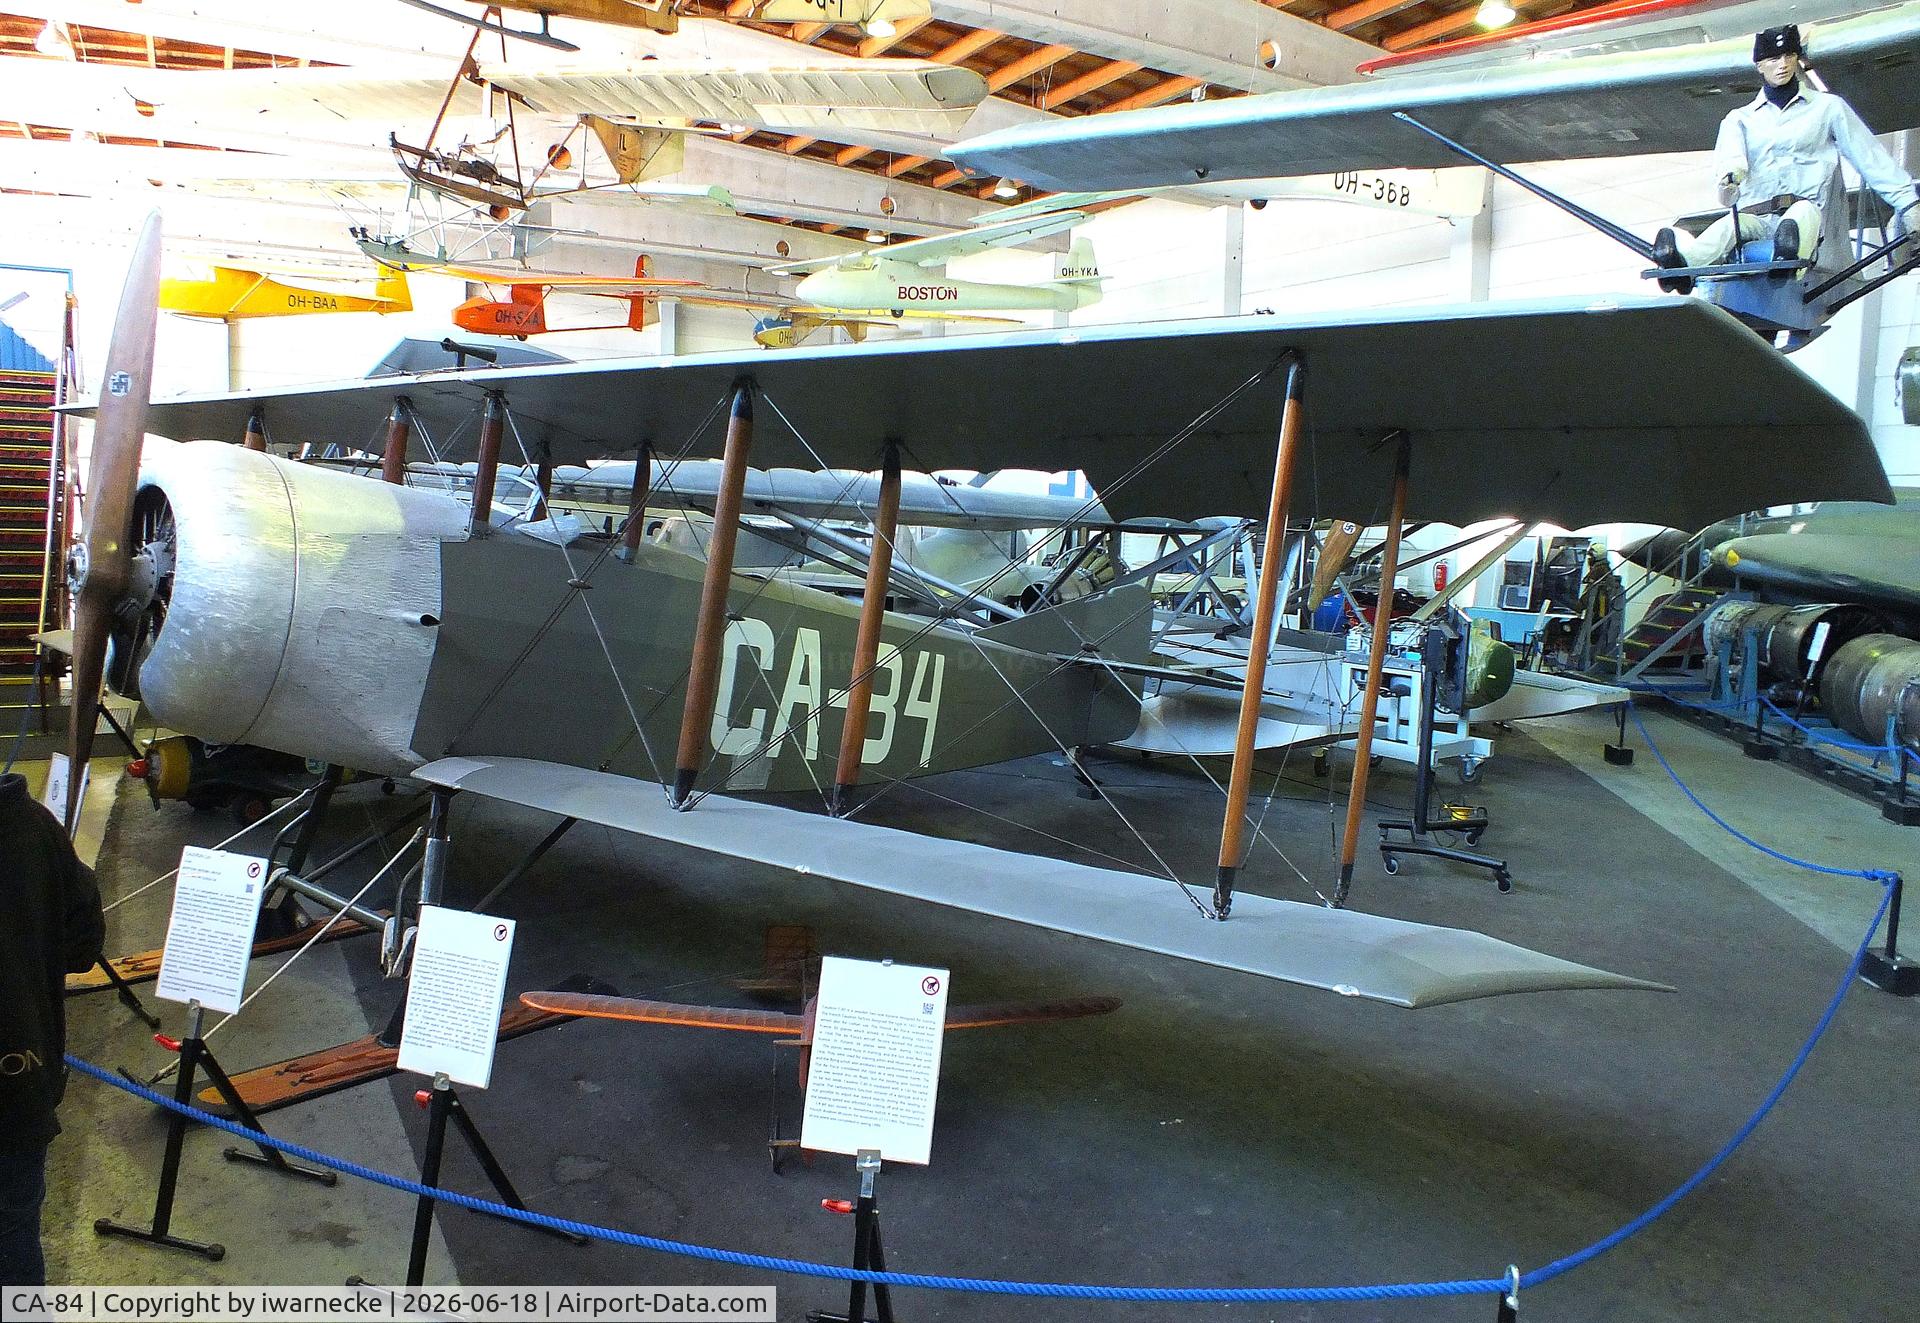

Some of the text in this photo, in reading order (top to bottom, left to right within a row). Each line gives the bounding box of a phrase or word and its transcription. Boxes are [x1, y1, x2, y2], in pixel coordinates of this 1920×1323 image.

[1334, 172, 1411, 207] OH-368
[1061, 267, 1099, 277] OH-YKA
[898, 286, 958, 301] BOSTON
[288, 294, 338, 310] OH-BAA
